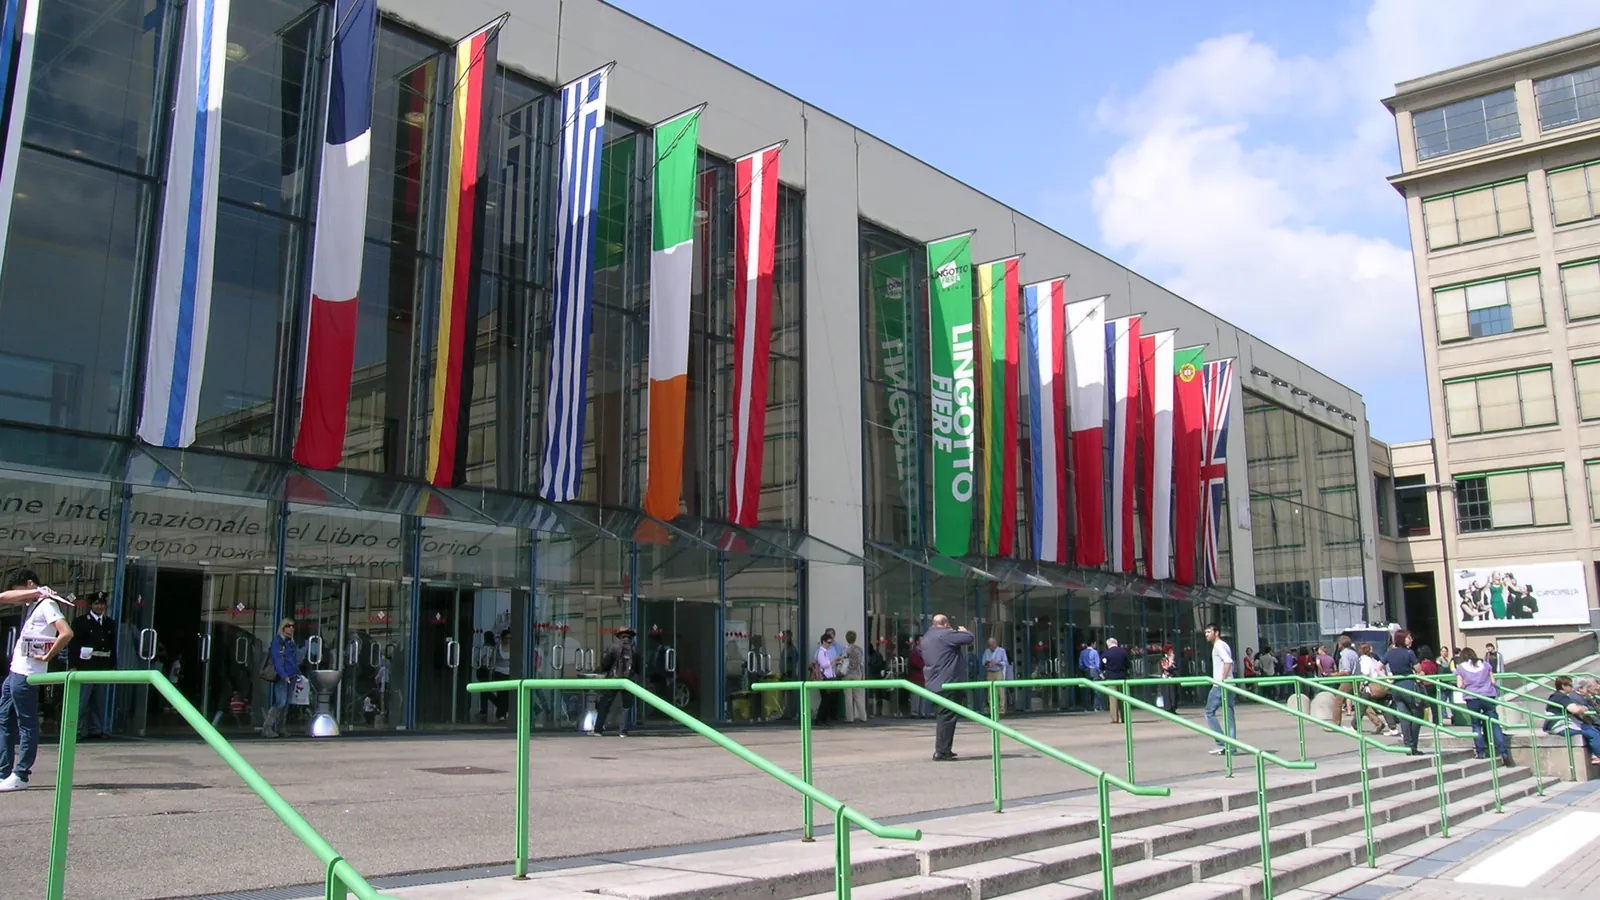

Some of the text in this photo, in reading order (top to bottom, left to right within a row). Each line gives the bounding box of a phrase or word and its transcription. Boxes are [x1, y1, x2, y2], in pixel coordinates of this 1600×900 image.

[930, 264, 968, 280] LINGOTTO
[931, 372, 953, 454] FIERE
[952, 322, 974, 502] LINGOTTO
[0, 497, 43, 514] ne
[55, 496, 260, 535] Intenazionale
[315, 525, 378, 547] Libro
